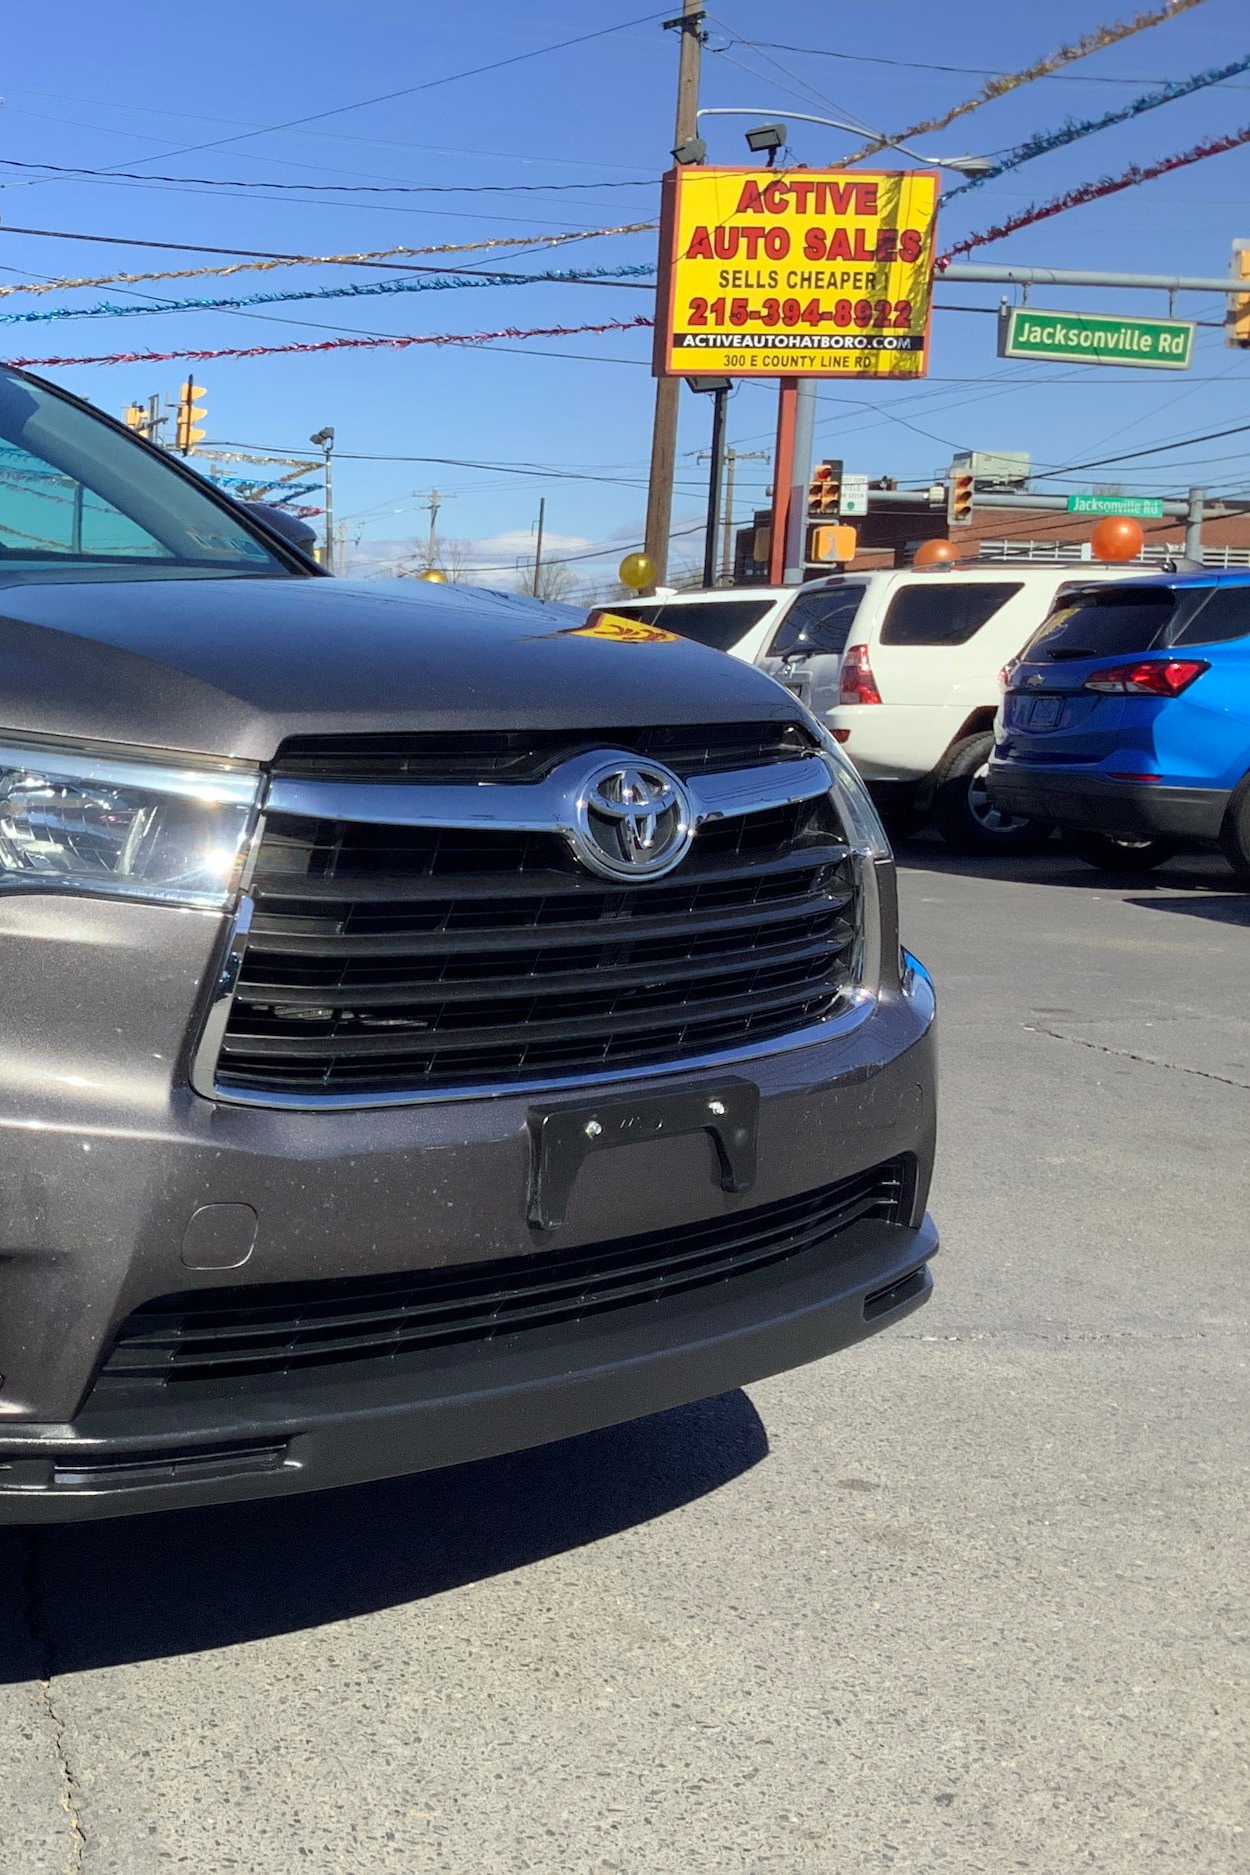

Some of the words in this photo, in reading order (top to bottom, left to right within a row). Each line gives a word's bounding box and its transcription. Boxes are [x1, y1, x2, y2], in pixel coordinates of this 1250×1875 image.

[736, 180, 879, 216] ACTIVE
[686, 226, 791, 260] AUTO
[803, 227, 922, 263] SALES
[719, 269, 779, 289] SELLS
[786, 270, 876, 291] CHEAPER
[687, 297, 912, 329] 215-394-8922
[682, 334, 912, 350] ACTIVEAUTOHATBORO.COM
[1018, 322, 1152, 352] Jacksonville
[1158, 333, 1185, 354] Rd
[723, 354, 746, 367] 300
[750, 355, 758, 367] E
[762, 355, 816, 368] COUNTY
[820, 356, 851, 368] LINE
[854, 356, 871, 369] RD
[1073, 497, 1141, 514] Jacksonville
[1143, 500, 1158, 515] Rd
